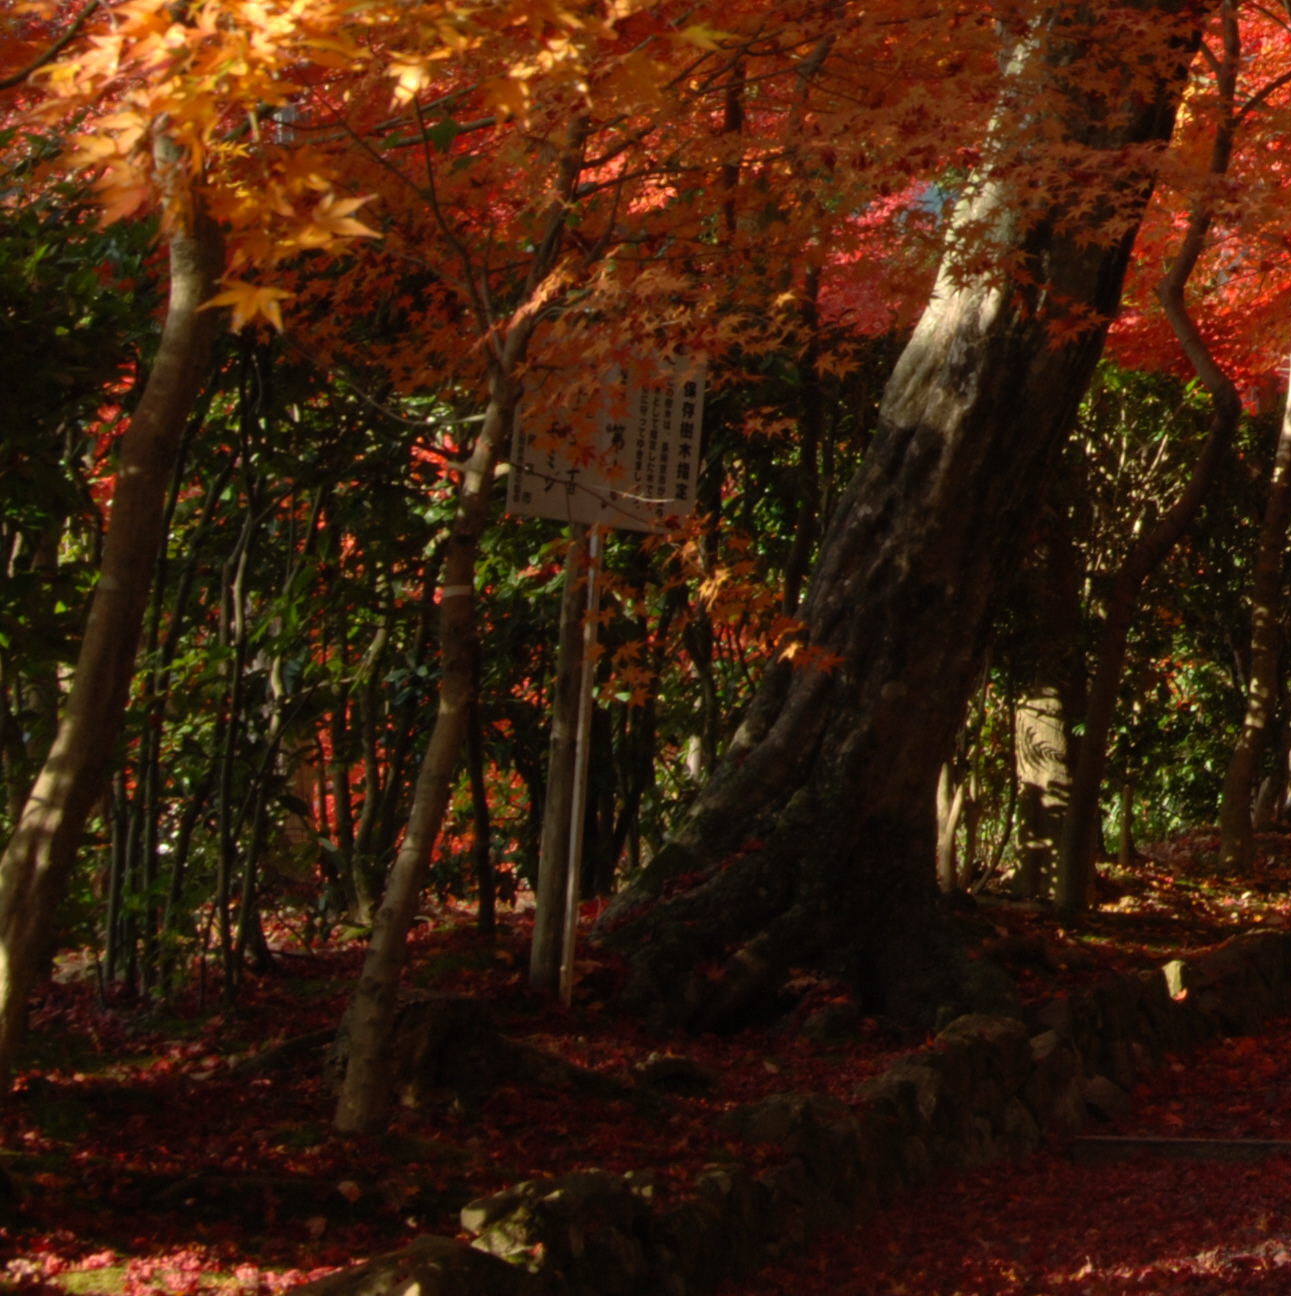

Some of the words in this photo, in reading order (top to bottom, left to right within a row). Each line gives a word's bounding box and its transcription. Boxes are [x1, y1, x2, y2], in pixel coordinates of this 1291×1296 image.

[675, 381, 697, 500] 保存樹木指定
